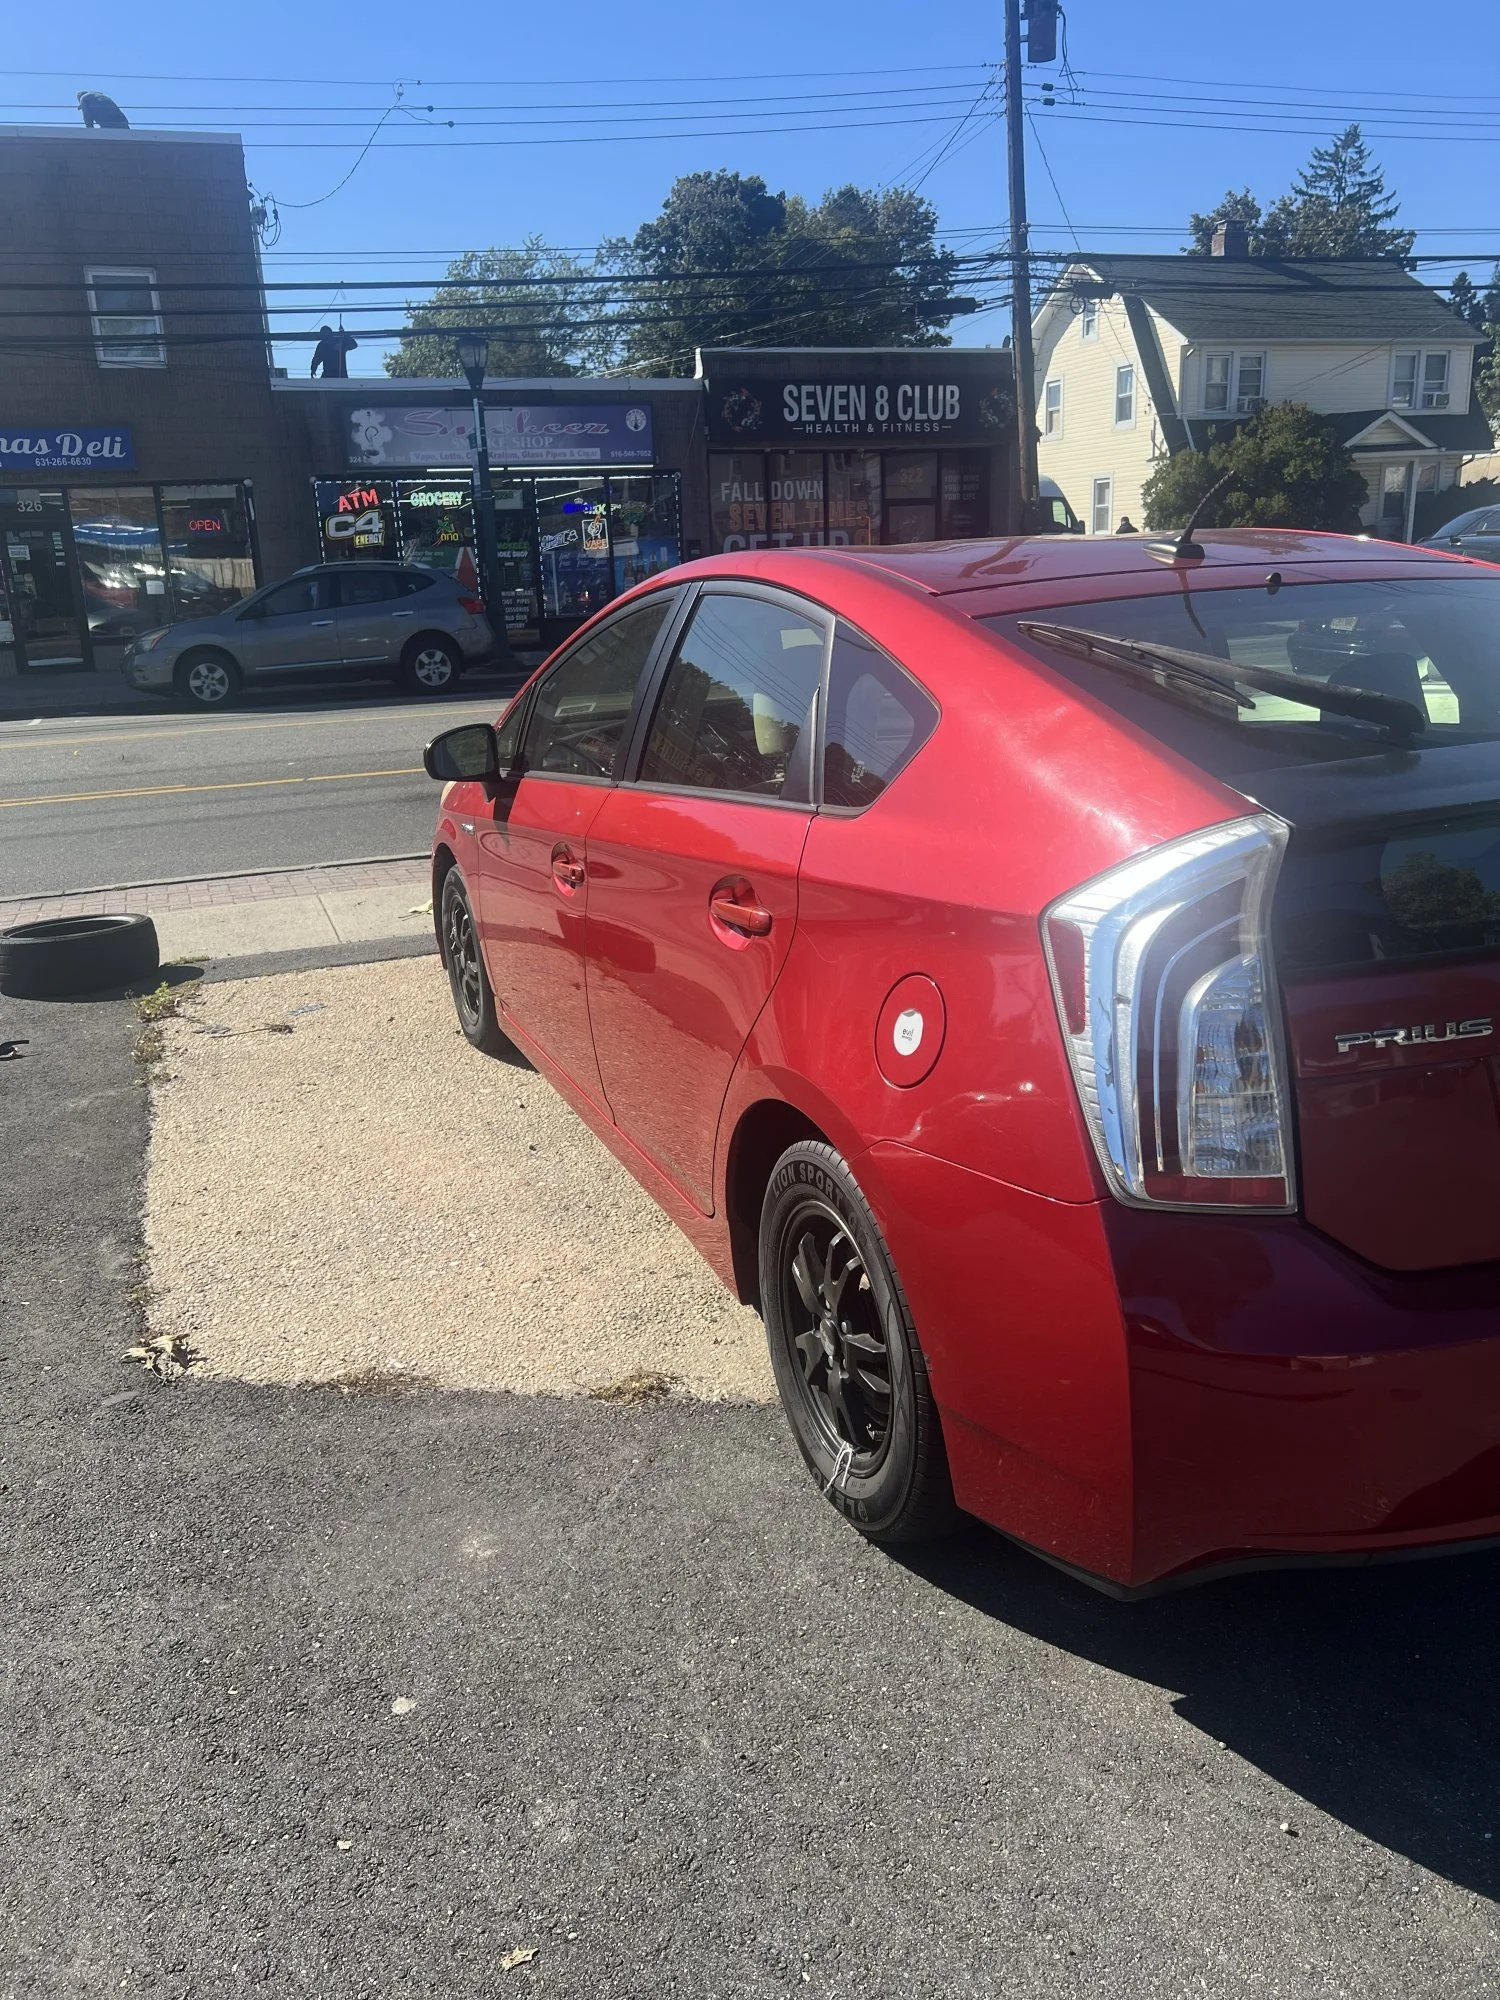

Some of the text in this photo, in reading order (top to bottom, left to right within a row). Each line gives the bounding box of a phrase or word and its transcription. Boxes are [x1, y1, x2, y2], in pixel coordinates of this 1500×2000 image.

[783, 384, 961, 423] SEVEN 8 CLUB
[806, 422, 940, 434] HEALTH & FITNESS
[56, 433, 127, 458] Deli
[512, 436, 553, 448] SHOP
[35, 457, 92, 467] 631-266-6630
[900, 467, 923, 483] 322
[410, 491, 463, 506] GROCERY
[721, 480, 824, 501] FALL DOWN
[17, 500, 43, 512] 326
[338, 488, 379, 513] ATM
[729, 499, 869, 532] SEVEN TIMES
[189, 520, 221, 532] OPEN
[327, 510, 384, 539] C4
[355, 532, 383, 546] ENERGY
[585, 539, 606, 549] VAPE
[1334, 1017, 1494, 1053] PRIUS
[772, 1164, 796, 1198] LION
[800, 1162, 844, 1208] SPORT
